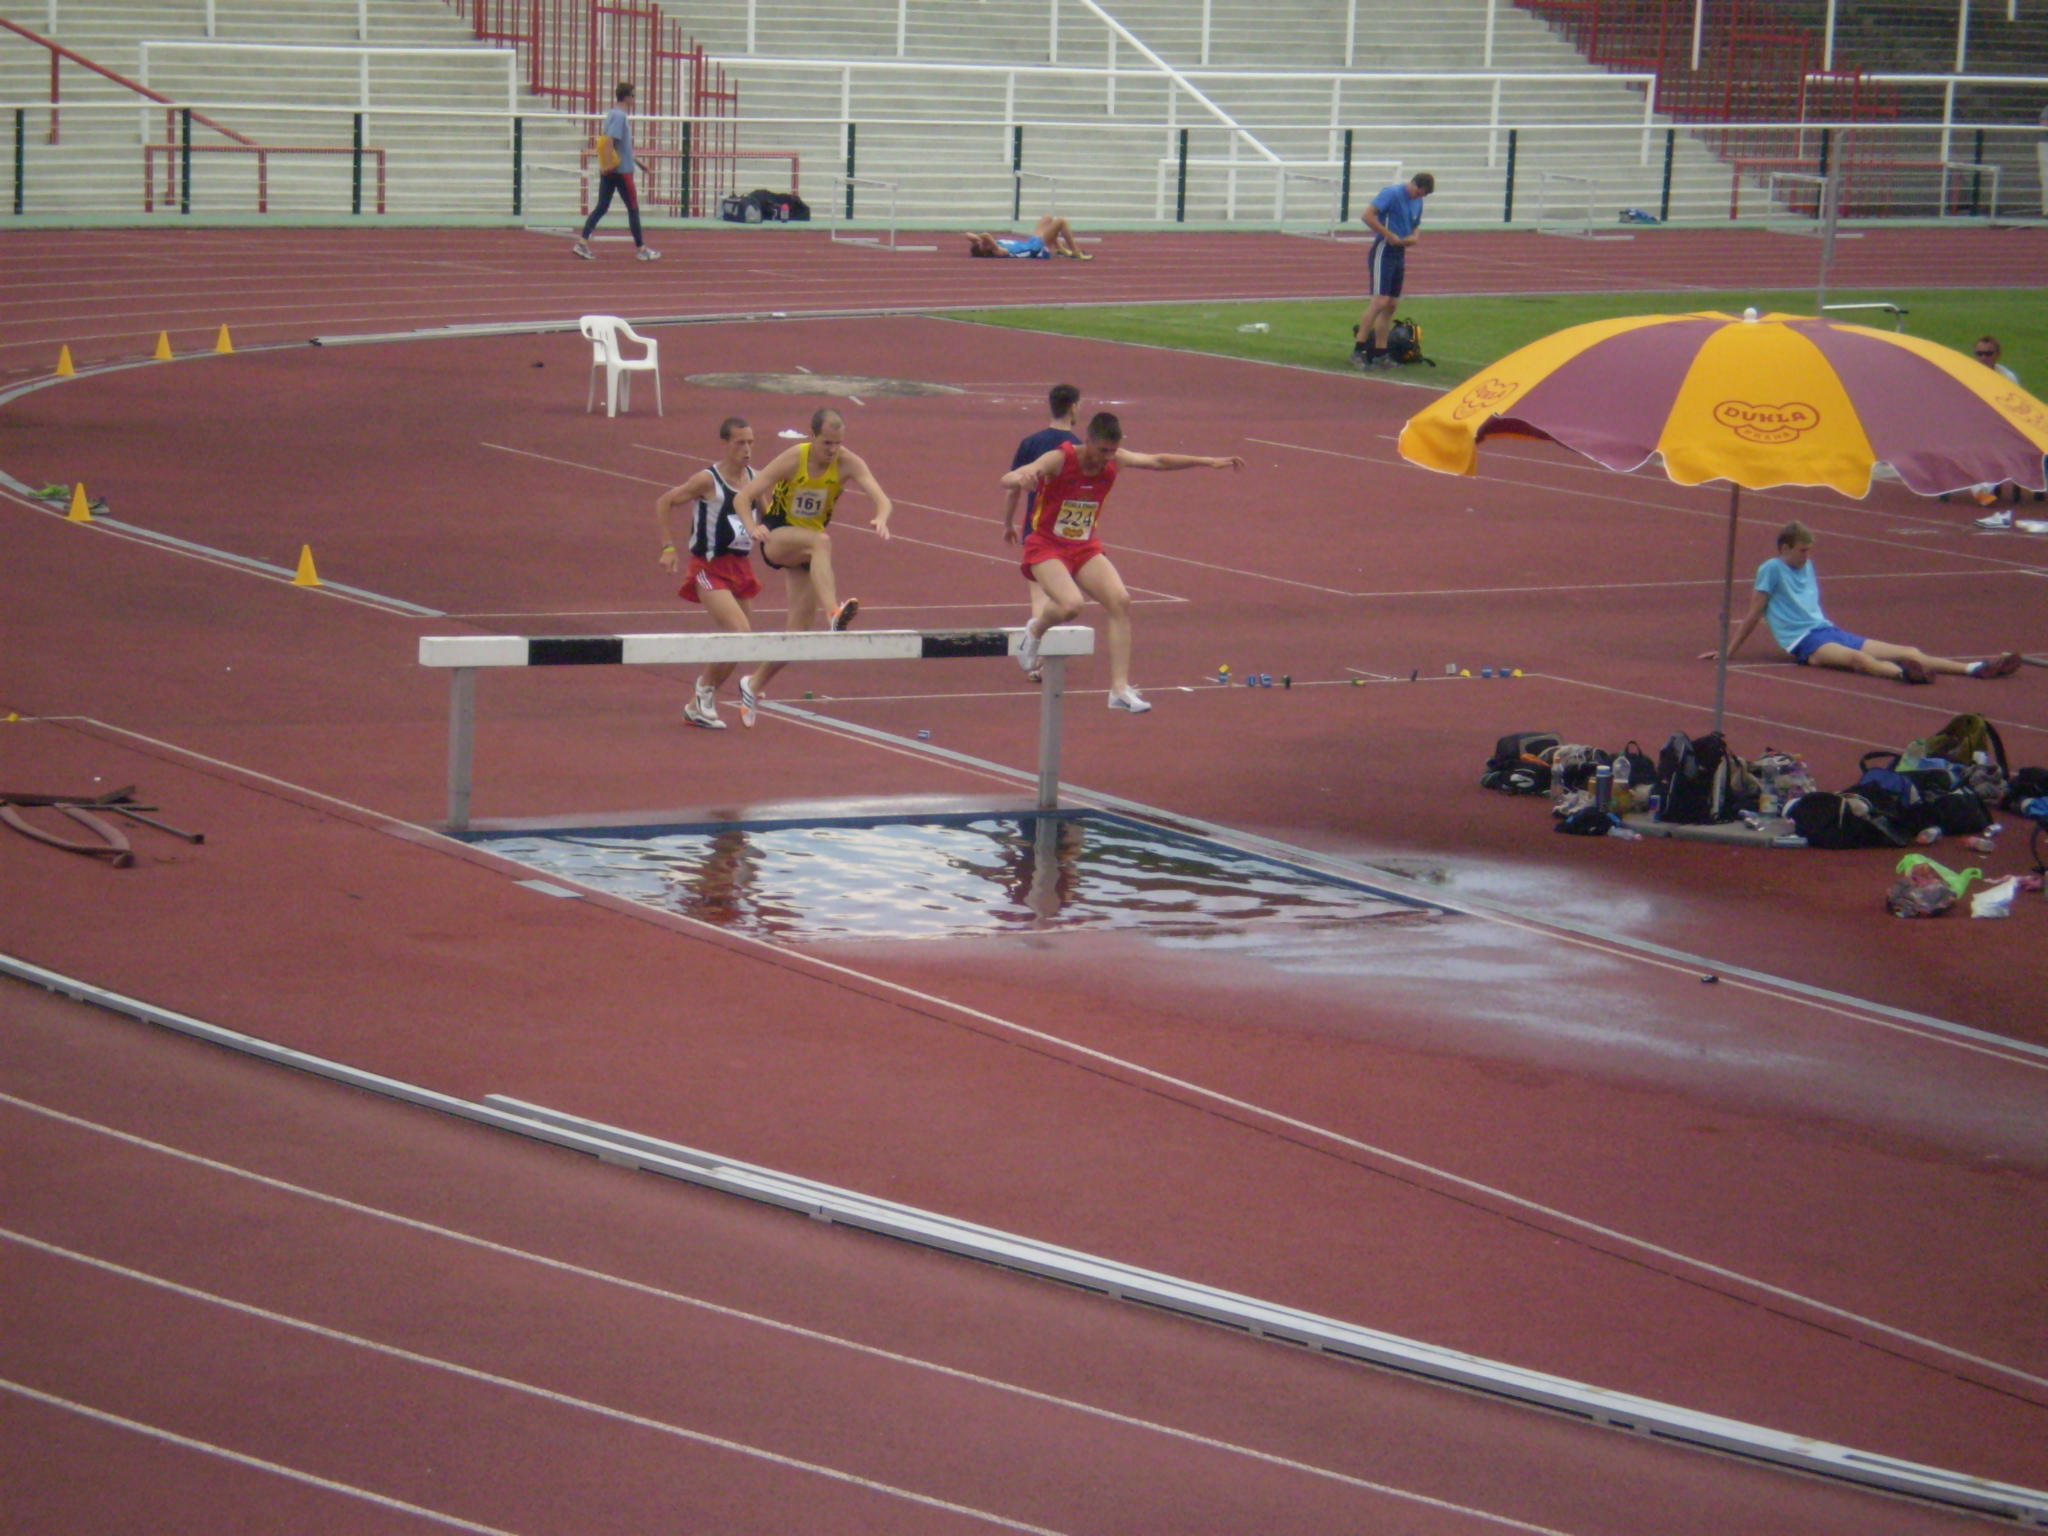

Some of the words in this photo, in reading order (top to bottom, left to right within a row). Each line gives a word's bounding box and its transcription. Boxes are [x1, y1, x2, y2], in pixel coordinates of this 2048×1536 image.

[1723, 406, 1808, 423] DUKLA
[796, 496, 822, 511] 161
[1059, 509, 1093, 527] 224
